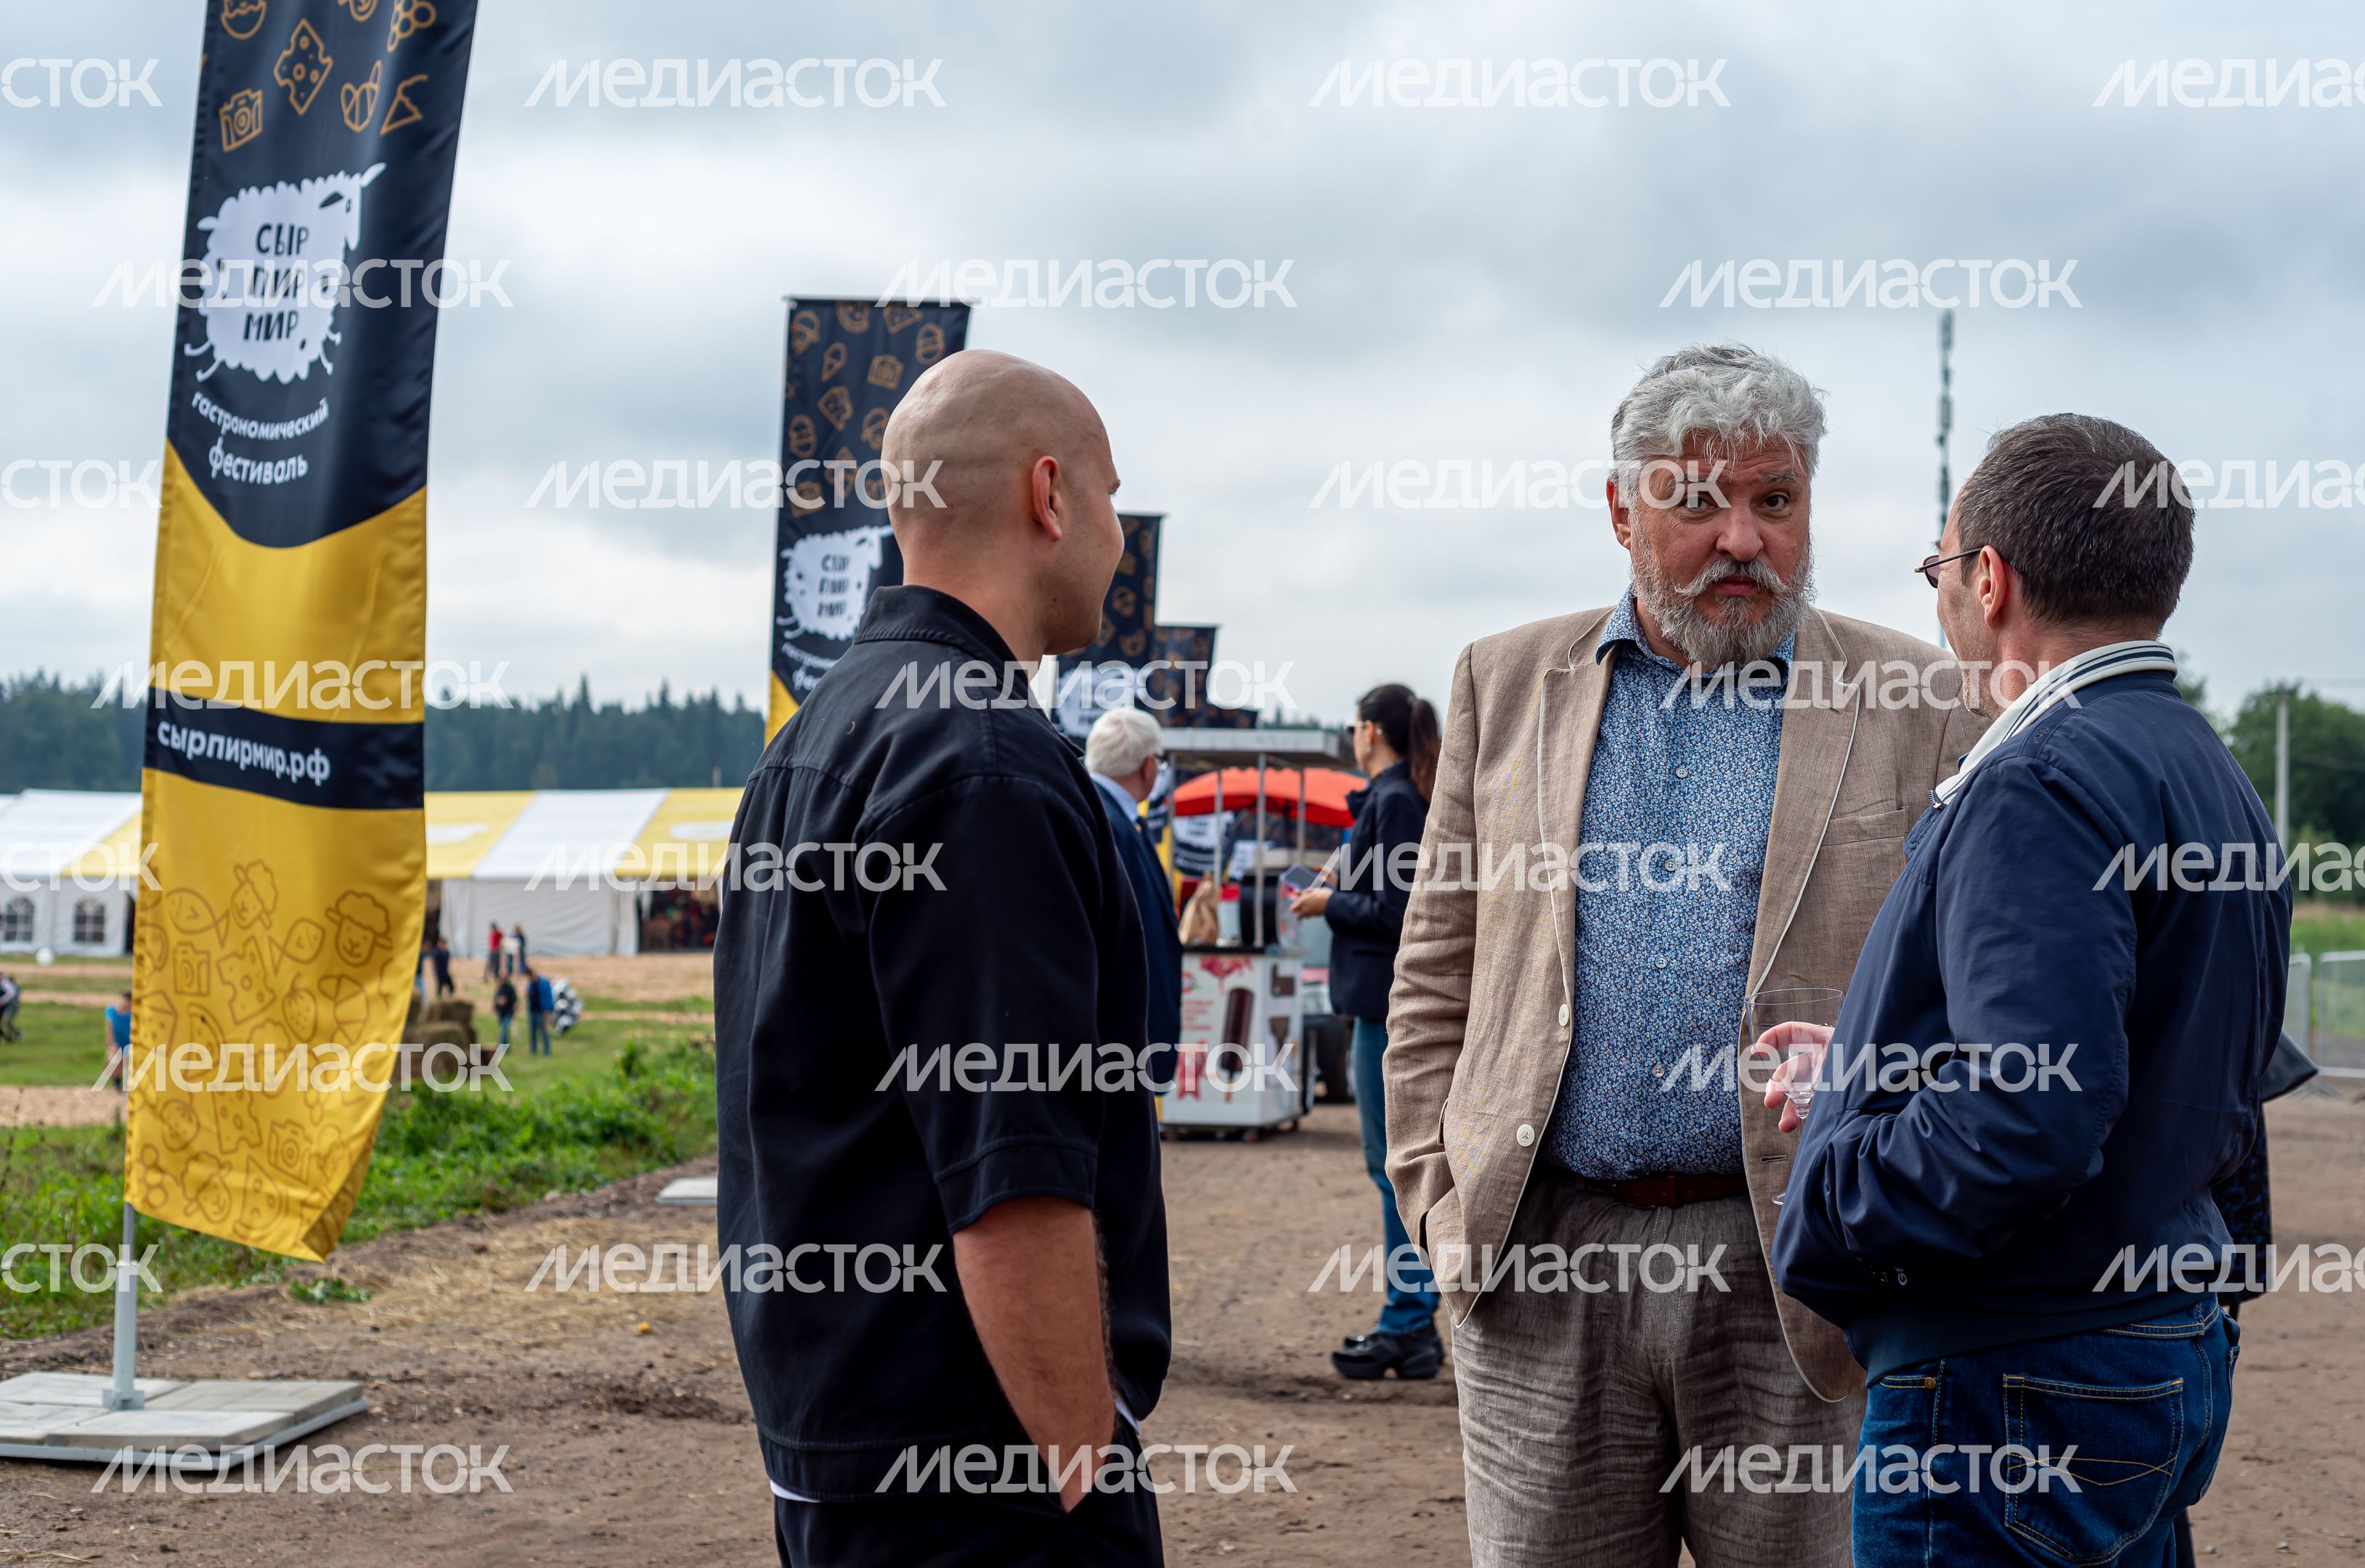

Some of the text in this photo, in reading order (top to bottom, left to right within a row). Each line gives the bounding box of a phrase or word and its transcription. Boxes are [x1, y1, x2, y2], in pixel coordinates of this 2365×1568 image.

[256, 224, 309, 256] СЫР
[248, 266, 305, 298] ПИР
[244, 312, 298, 340] МИР
[192, 391, 329, 440] гастрономический
[208, 436, 309, 484] фестиваль
[158, 721, 331, 786] сырпирмир.рф
